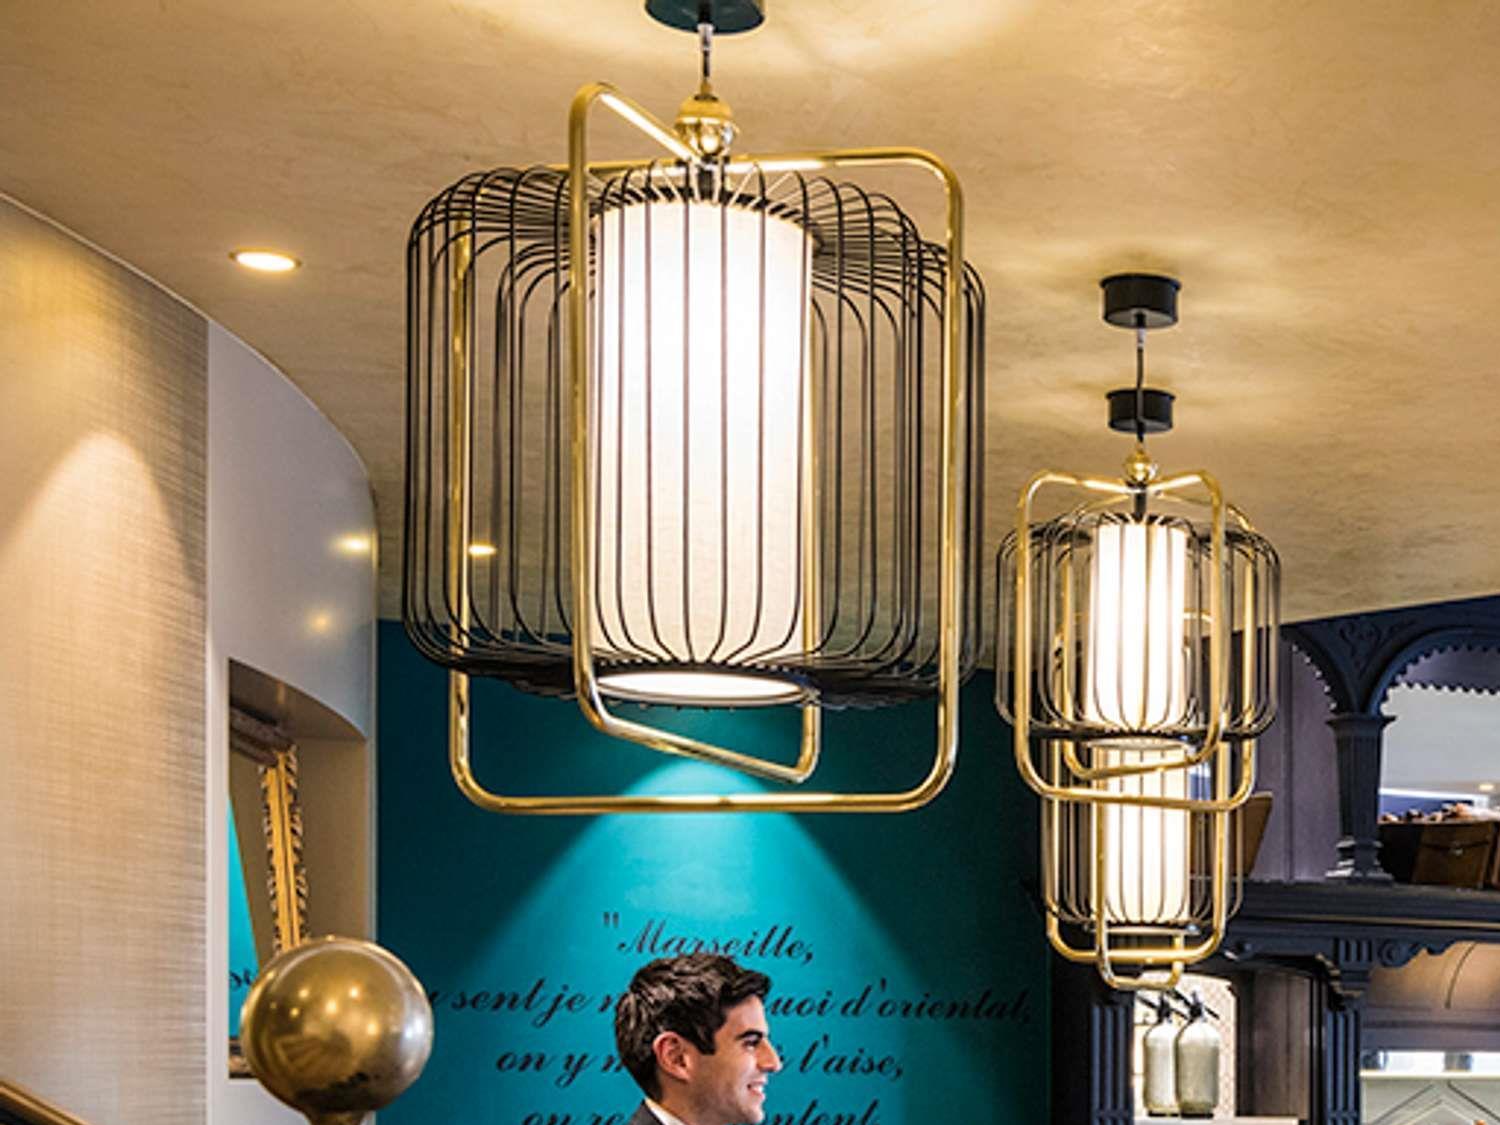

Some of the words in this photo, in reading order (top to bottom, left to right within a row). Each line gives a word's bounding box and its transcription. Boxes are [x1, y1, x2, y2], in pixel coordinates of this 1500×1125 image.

[531, 983, 590, 1029] je
[766, 987, 834, 1016] uoi
[496, 1052, 550, 1073] on
[554, 1053, 592, 1089] y
[799, 1034, 903, 1080] l'aise,
